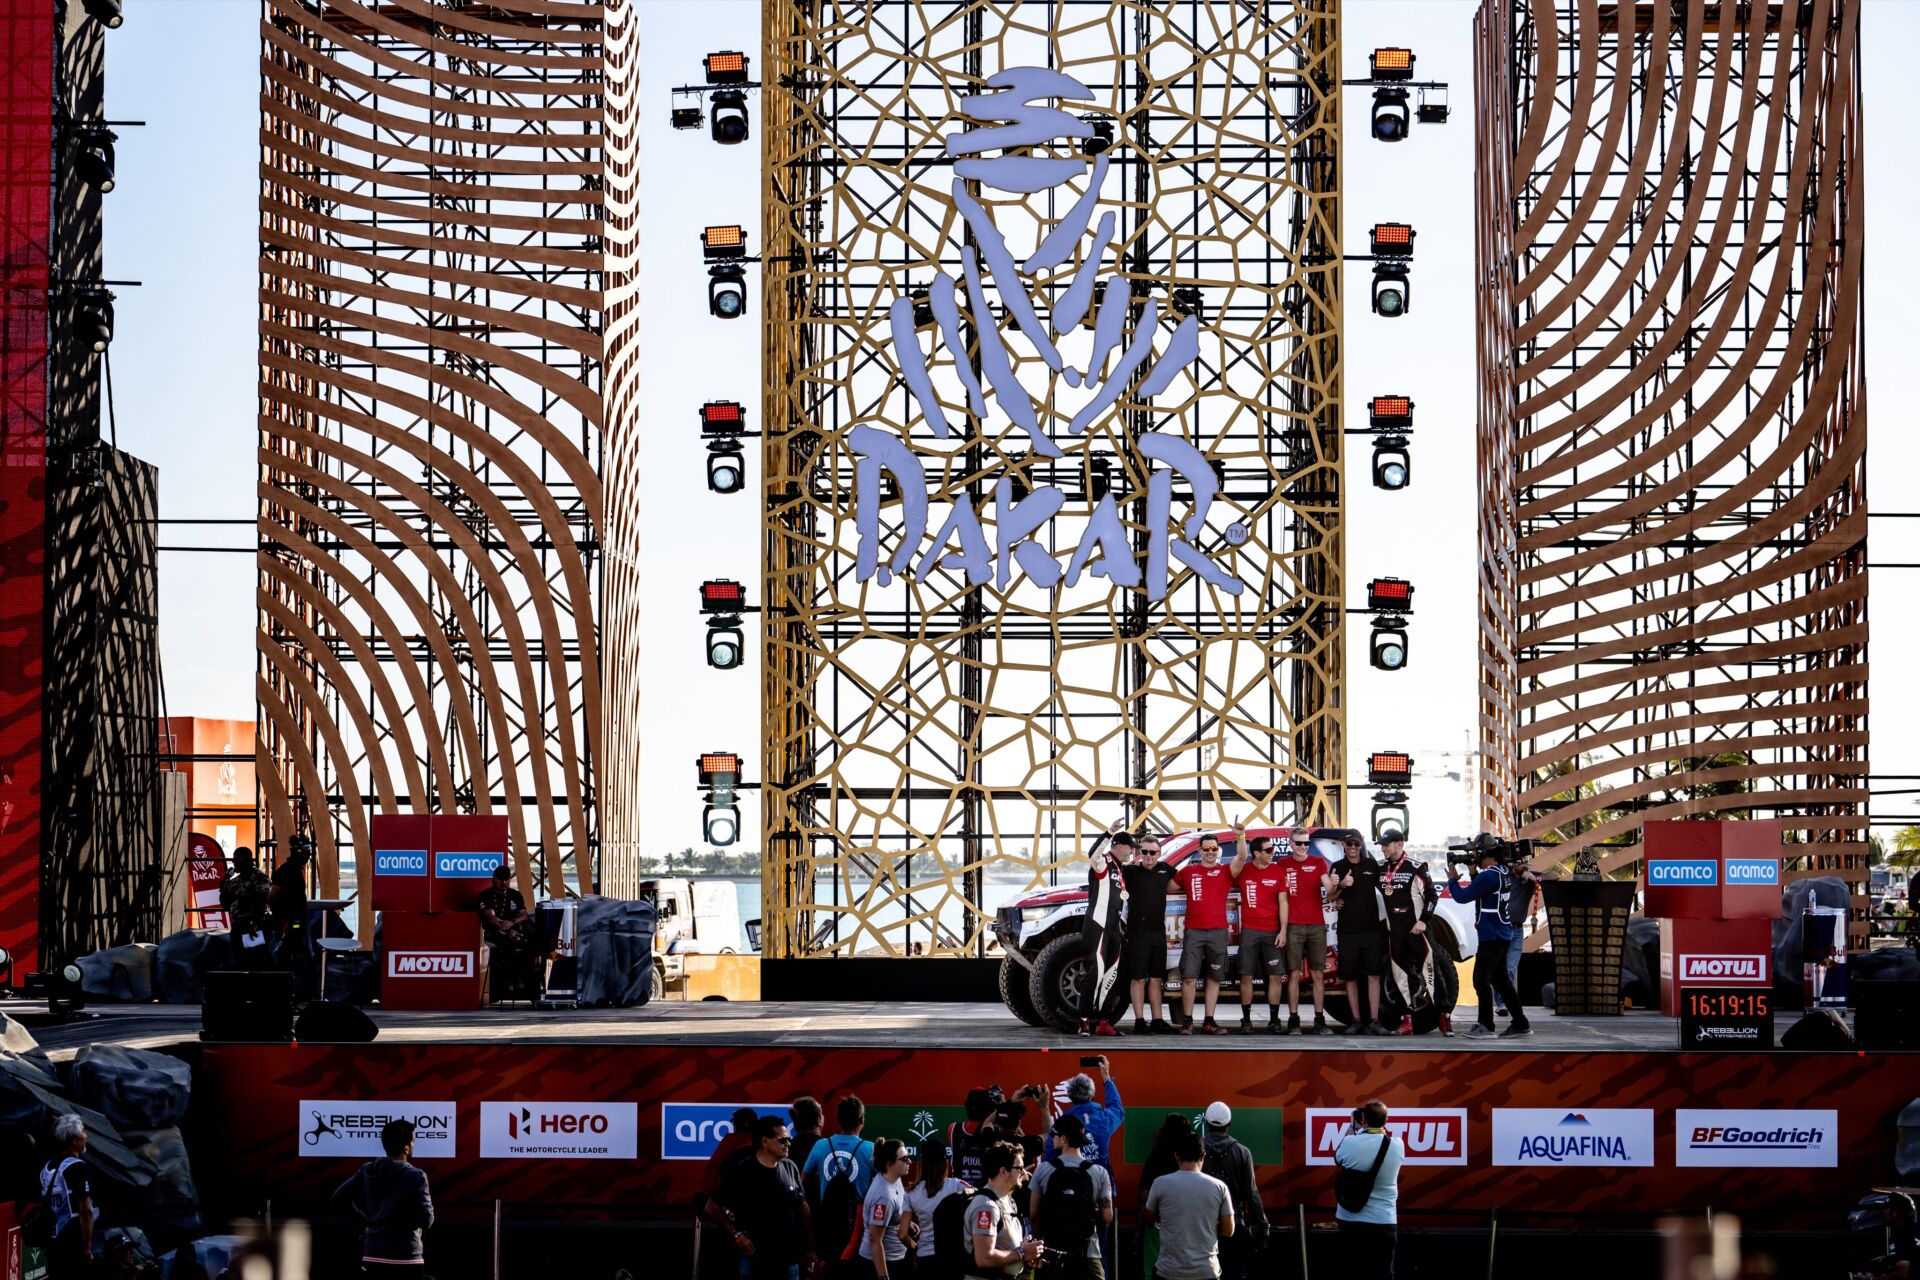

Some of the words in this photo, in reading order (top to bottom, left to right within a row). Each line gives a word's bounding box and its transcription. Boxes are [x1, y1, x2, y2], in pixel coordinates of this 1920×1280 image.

[847, 424, 1244, 602] DAKAR
[379, 856, 424, 869] aramco
[440, 858, 499, 872] aramco
[192, 869, 220, 881] DAKAR
[1653, 866, 1712, 879] aramco
[1729, 865, 1774, 879] aramco
[398, 957, 465, 972] MOTUL
[1689, 960, 1757, 975] MOTUL
[1690, 995, 1767, 1016] 16:19:15
[346, 1131, 448, 1139] TIMCES
[1318, 1122, 1455, 1152] MTUL
[1691, 1127, 1823, 1143] BFGoodrich
[1518, 1135, 1627, 1161] AQUAFINA
[963, 1156, 983, 1167] POOL
